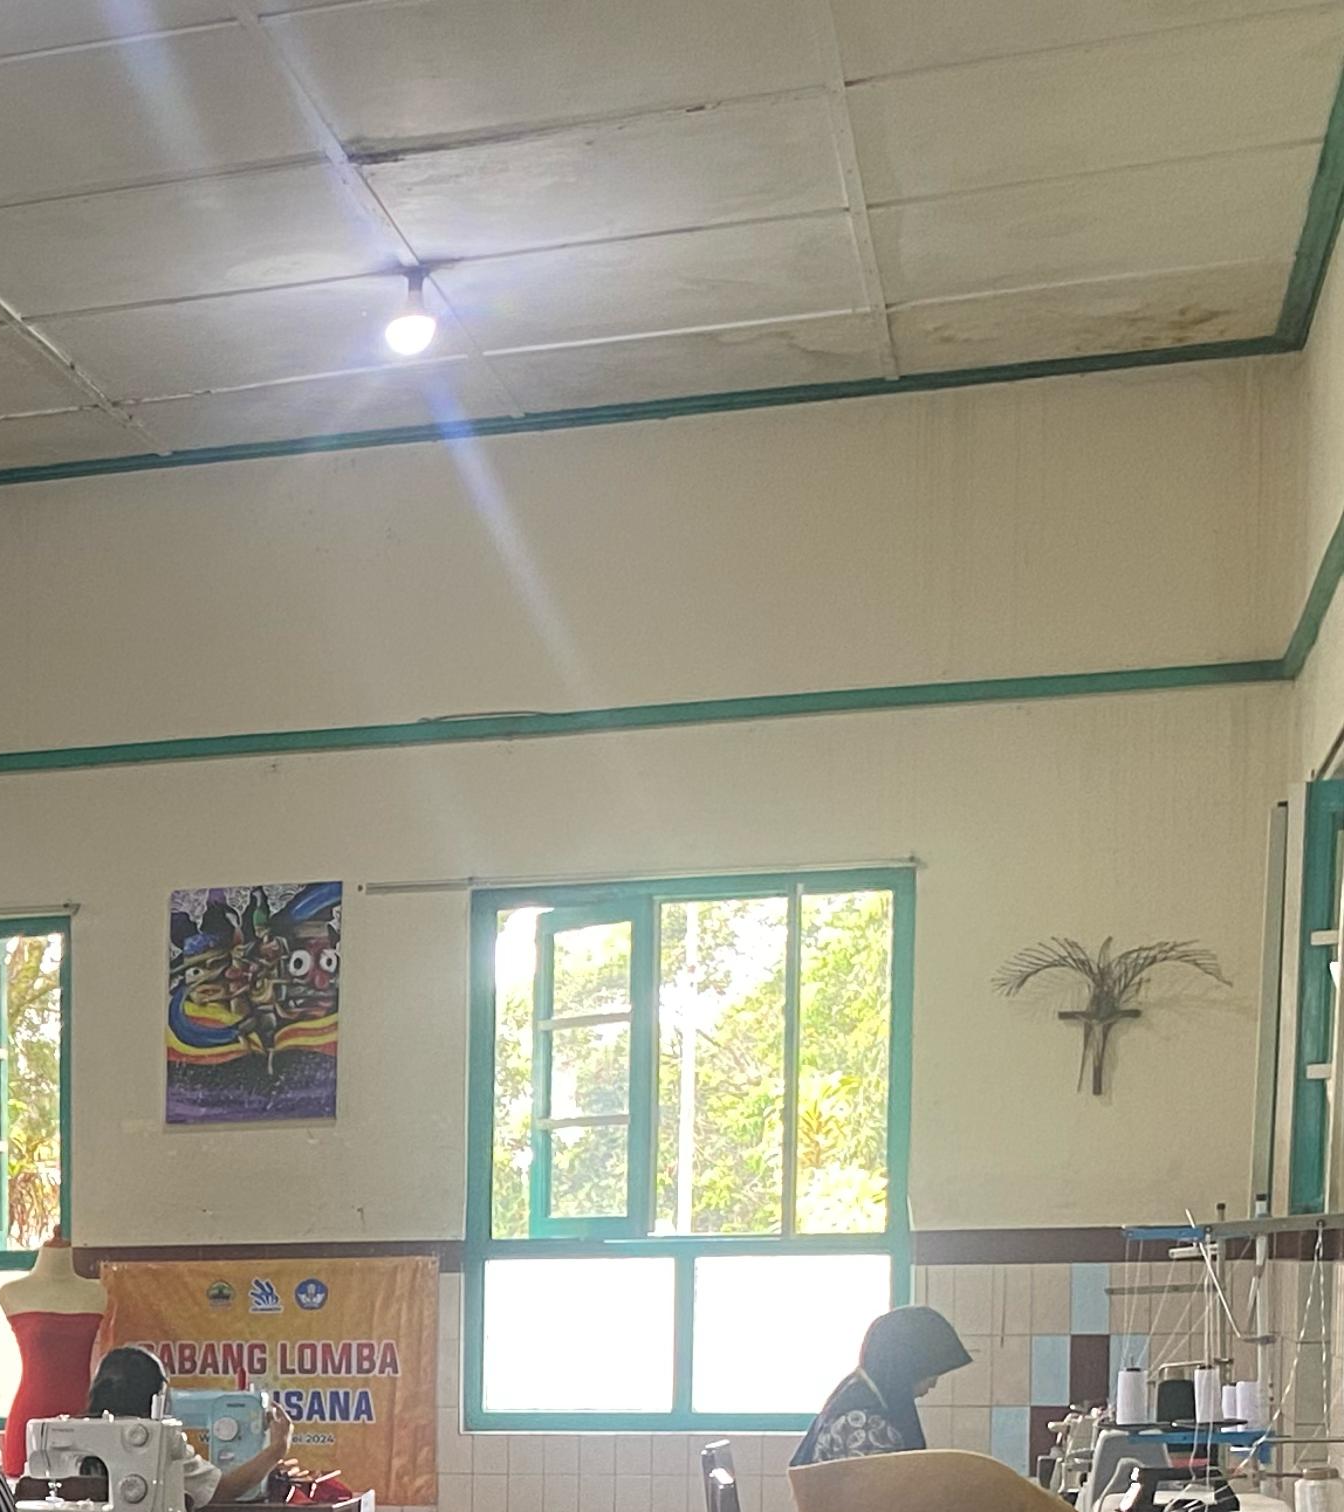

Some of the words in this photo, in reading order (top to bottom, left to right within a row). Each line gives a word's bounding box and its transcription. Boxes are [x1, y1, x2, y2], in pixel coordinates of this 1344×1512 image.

[138, 1342, 267, 1376] ABANG
[279, 1341, 399, 1376] LOMBA
[273, 1390, 375, 1422] SANA
[305, 1433, 335, 1444] 2024
